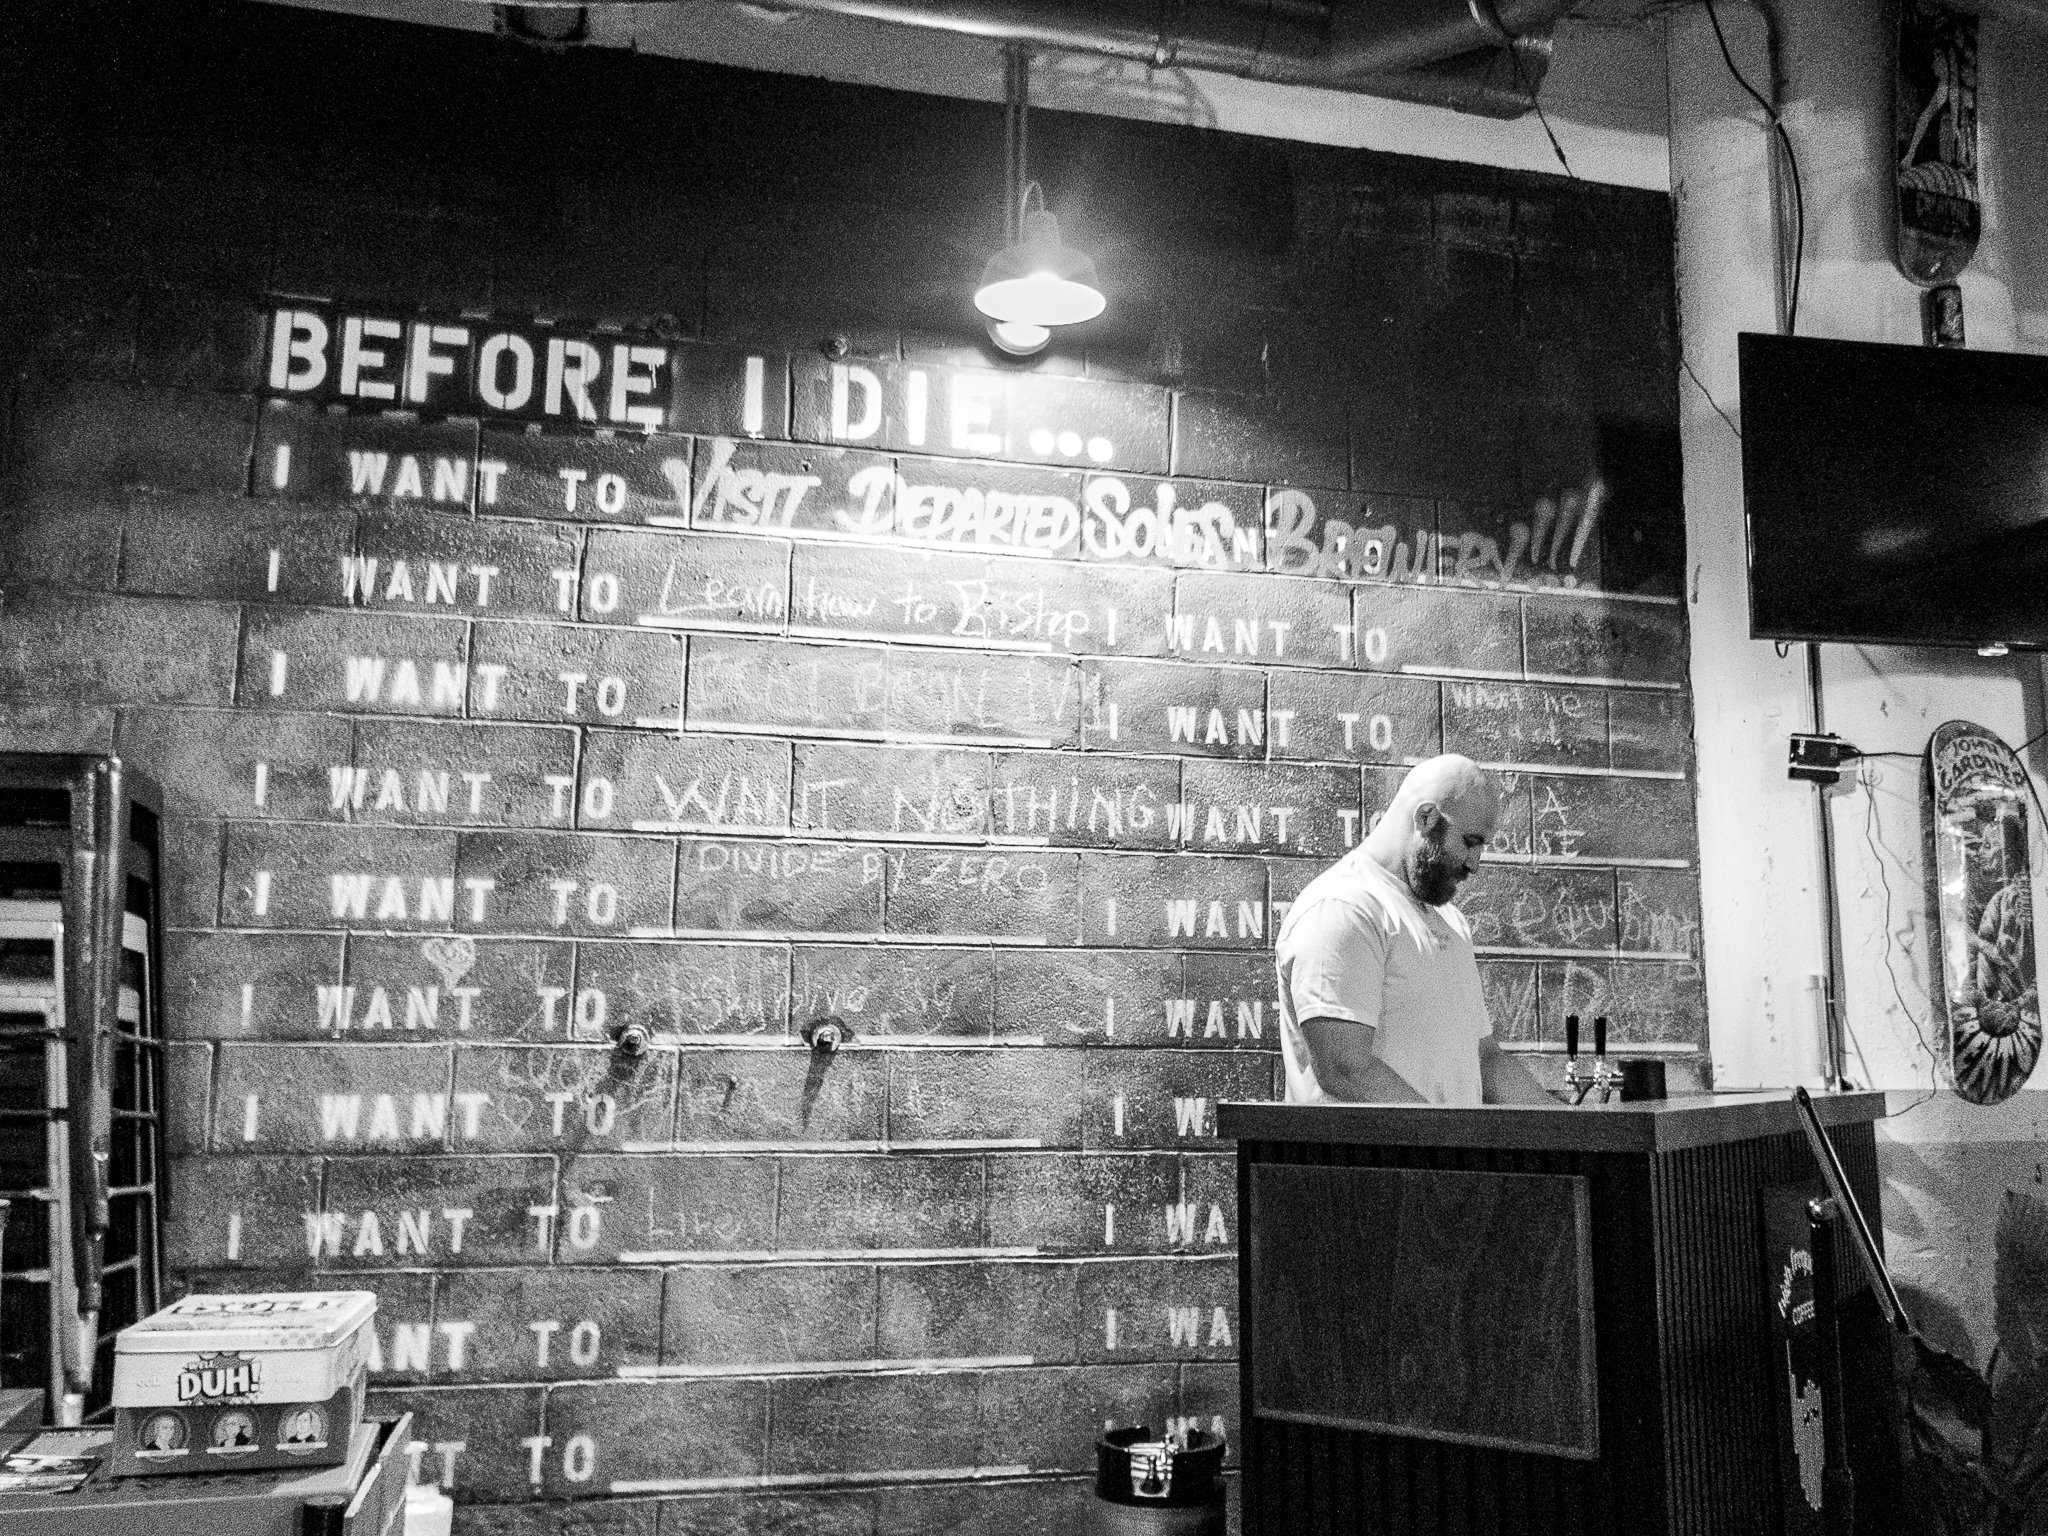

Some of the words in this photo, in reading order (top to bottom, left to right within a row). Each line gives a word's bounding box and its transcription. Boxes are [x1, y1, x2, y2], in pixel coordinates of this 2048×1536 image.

[269, 310, 667, 430] BEFORE
[743, 358, 764, 436] I
[274, 445, 290, 489] I
[350, 451, 507, 505] WANT
[560, 468, 627, 514] TO
[836, 466, 1081, 549] DEPARTED
[267, 549, 280, 592] I
[341, 556, 499, 606] WANT
[552, 568, 619, 614] TO
[893, 581, 938, 624] to
[1107, 608, 1117, 647] I
[1165, 613, 1291, 656] WANT
[1333, 623, 1389, 663] TO
[272, 651, 287, 696] I
[346, 656, 507, 711] WANT
[560, 671, 627, 717] TO
[1108, 702, 1118, 741] I
[1167, 705, 1296, 747] WANT
[1337, 712, 1394, 752] TO
[254, 763, 268, 807] I
[329, 766, 491, 814] WANT
[544, 774, 614, 819] TO
[1539, 786, 1569, 825] A
[1166, 803, 1293, 844] WANT
[1483, 829, 1586, 859] OUSE
[698, 843, 843, 879] DIVIDE
[922, 850, 1048, 895] ZERO
[254, 871, 272, 915] I
[331, 874, 495, 923] WANT
[549, 881, 618, 926] TO
[1107, 898, 1117, 937] I
[241, 984, 254, 1028] I
[316, 986, 482, 1033] WANT
[536, 987, 607, 1034] TO
[1105, 999, 1115, 1037] I
[1165, 1000, 1281, 1039] WAN
[243, 1095, 259, 1142] I
[321, 1093, 490, 1140] WANT
[546, 1093, 616, 1138] TO
[1113, 1095, 1125, 1137] I
[227, 1212, 242, 1261] I
[305, 1209, 474, 1258] WANT
[528, 1205, 602, 1252] TO
[1104, 1203, 1115, 1246] I
[1166, 1203, 1229, 1245] WA
[528, 1320, 602, 1368] TO
[1106, 1308, 1117, 1350] I
[1168, 1306, 1233, 1348] WA
[178, 1362, 262, 1401] DUH!
[521, 1434, 597, 1484] TO
